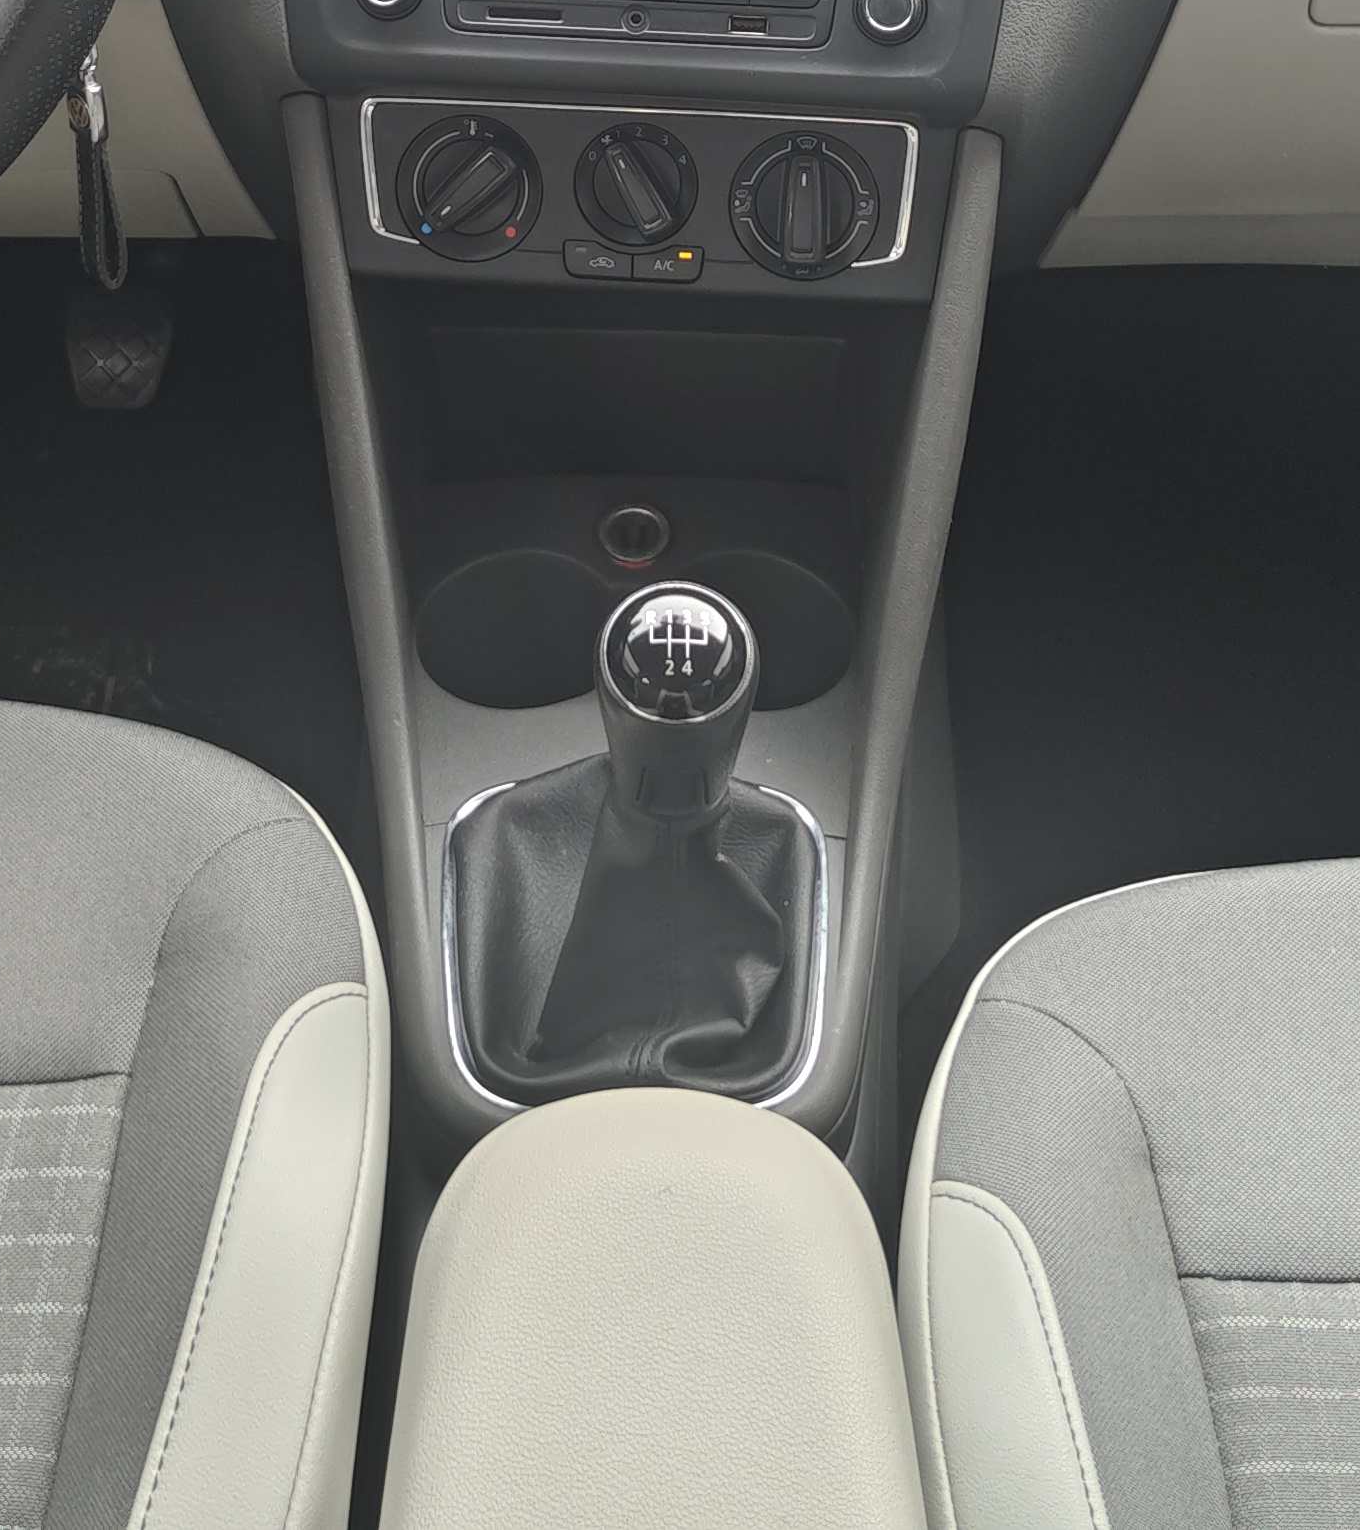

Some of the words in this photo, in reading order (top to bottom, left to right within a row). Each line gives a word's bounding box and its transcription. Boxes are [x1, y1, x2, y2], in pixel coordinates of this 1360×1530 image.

[635, 126, 643, 137] 2
[662, 135, 669, 146] 3
[679, 154, 687, 165] 4
[654, 259, 675, 271] A/C
[665, 609, 673, 624] 1
[665, 659, 675, 676] 2
[681, 659, 694, 676] 4
